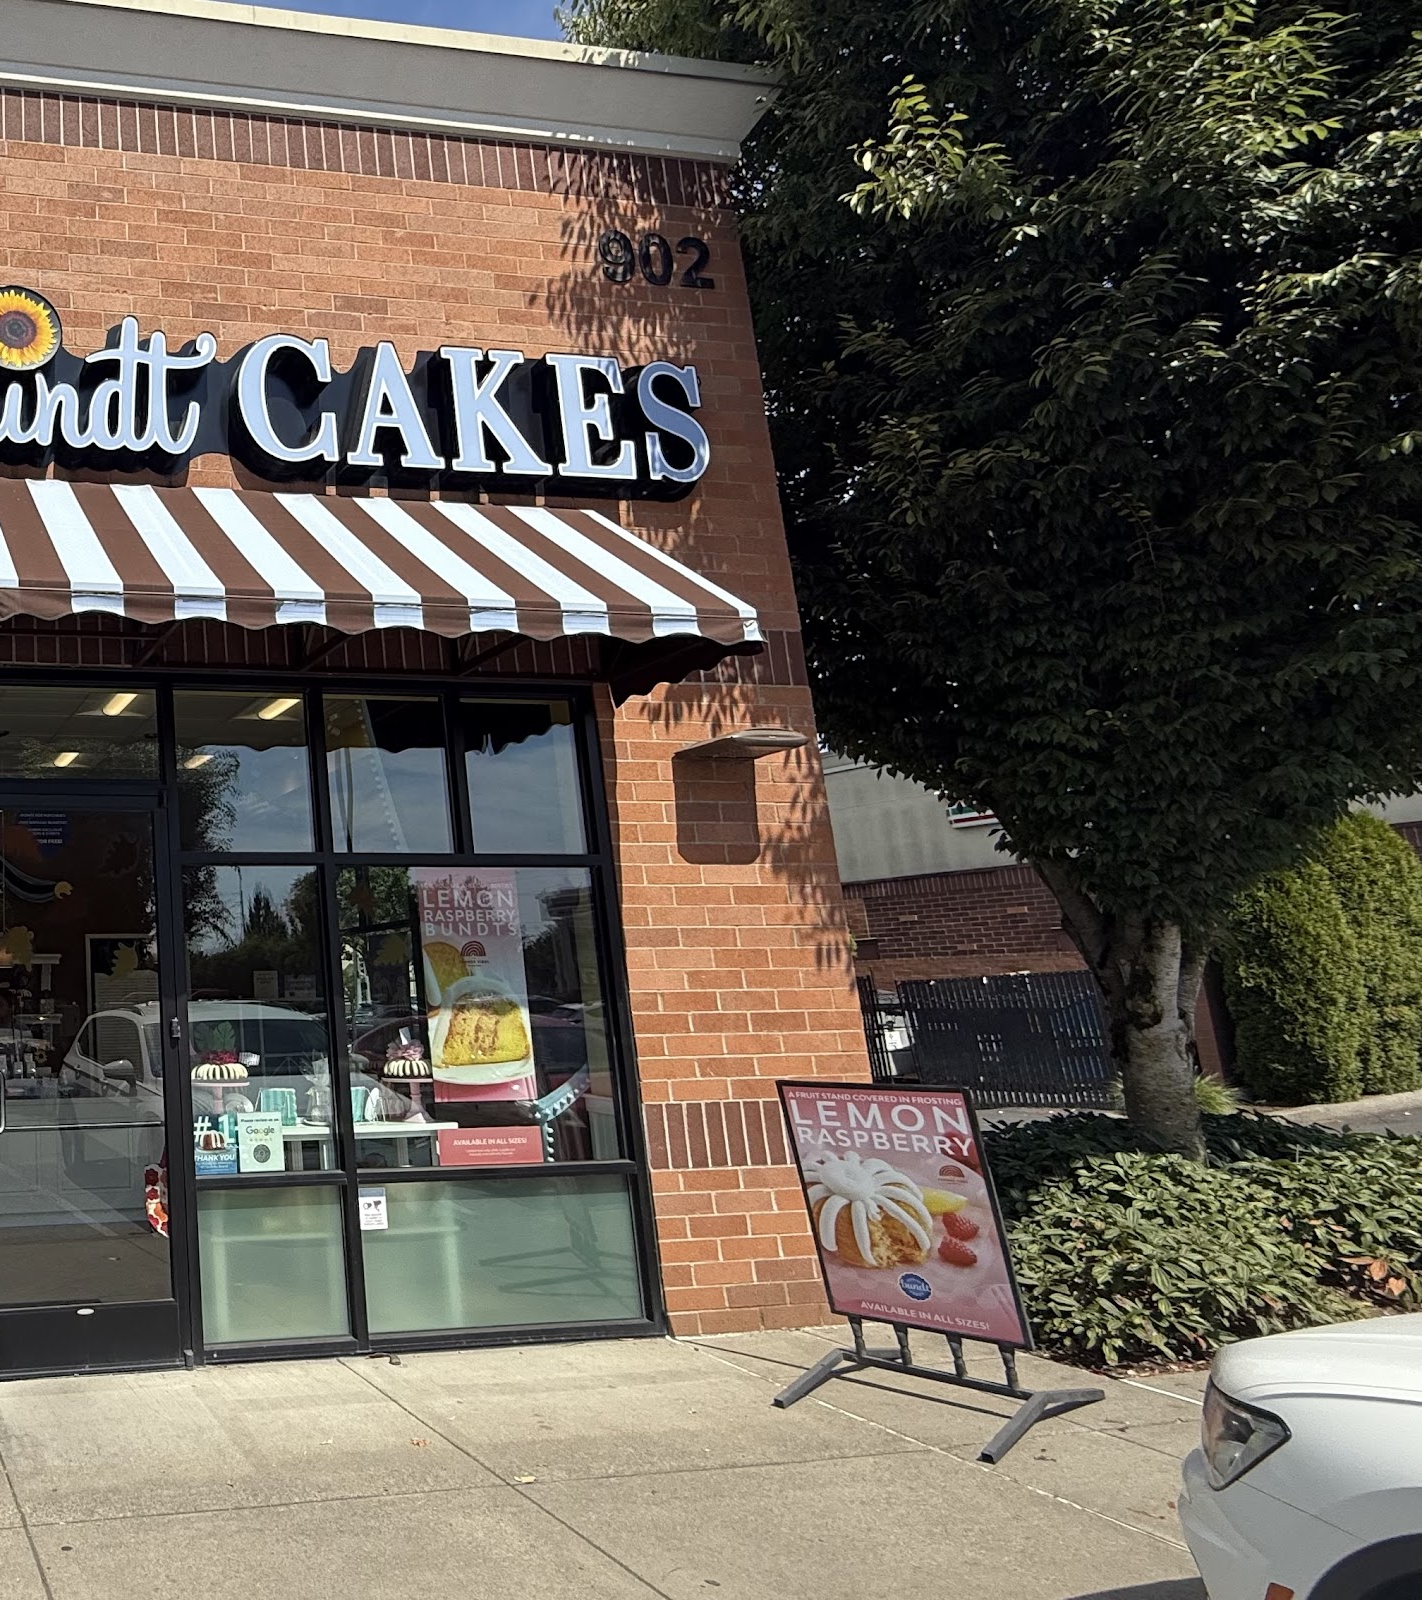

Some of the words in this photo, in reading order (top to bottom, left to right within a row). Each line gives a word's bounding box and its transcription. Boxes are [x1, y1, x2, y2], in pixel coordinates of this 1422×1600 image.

[599, 229, 715, 289] 902
[237, 334, 711, 483] CAKES
[423, 890, 513, 908] LEMON
[424, 909, 515, 922] RASPBERRY
[425, 922, 517, 936] BUNDTS
[821, 1093, 852, 1101] STAND
[852, 1094, 898, 1103] COVERED
[899, 1096, 911, 1104] IN
[912, 1096, 963, 1106] FROSTING
[790, 1099, 970, 1135] LEMON
[245, 1125, 275, 1136] Google
[453, 1138, 487, 1146] AVAILABLE
[797, 1126, 972, 1157] RASPBERRY
[195, 1154, 219, 1162] THANK
[900, 1278, 931, 1292] bundt
[860, 1301, 917, 1318] AVAILABLE
[918, 1311, 933, 1320] IN
[934, 1314, 954, 1325] ALL
[954, 1317, 991, 1331] SIZES!
